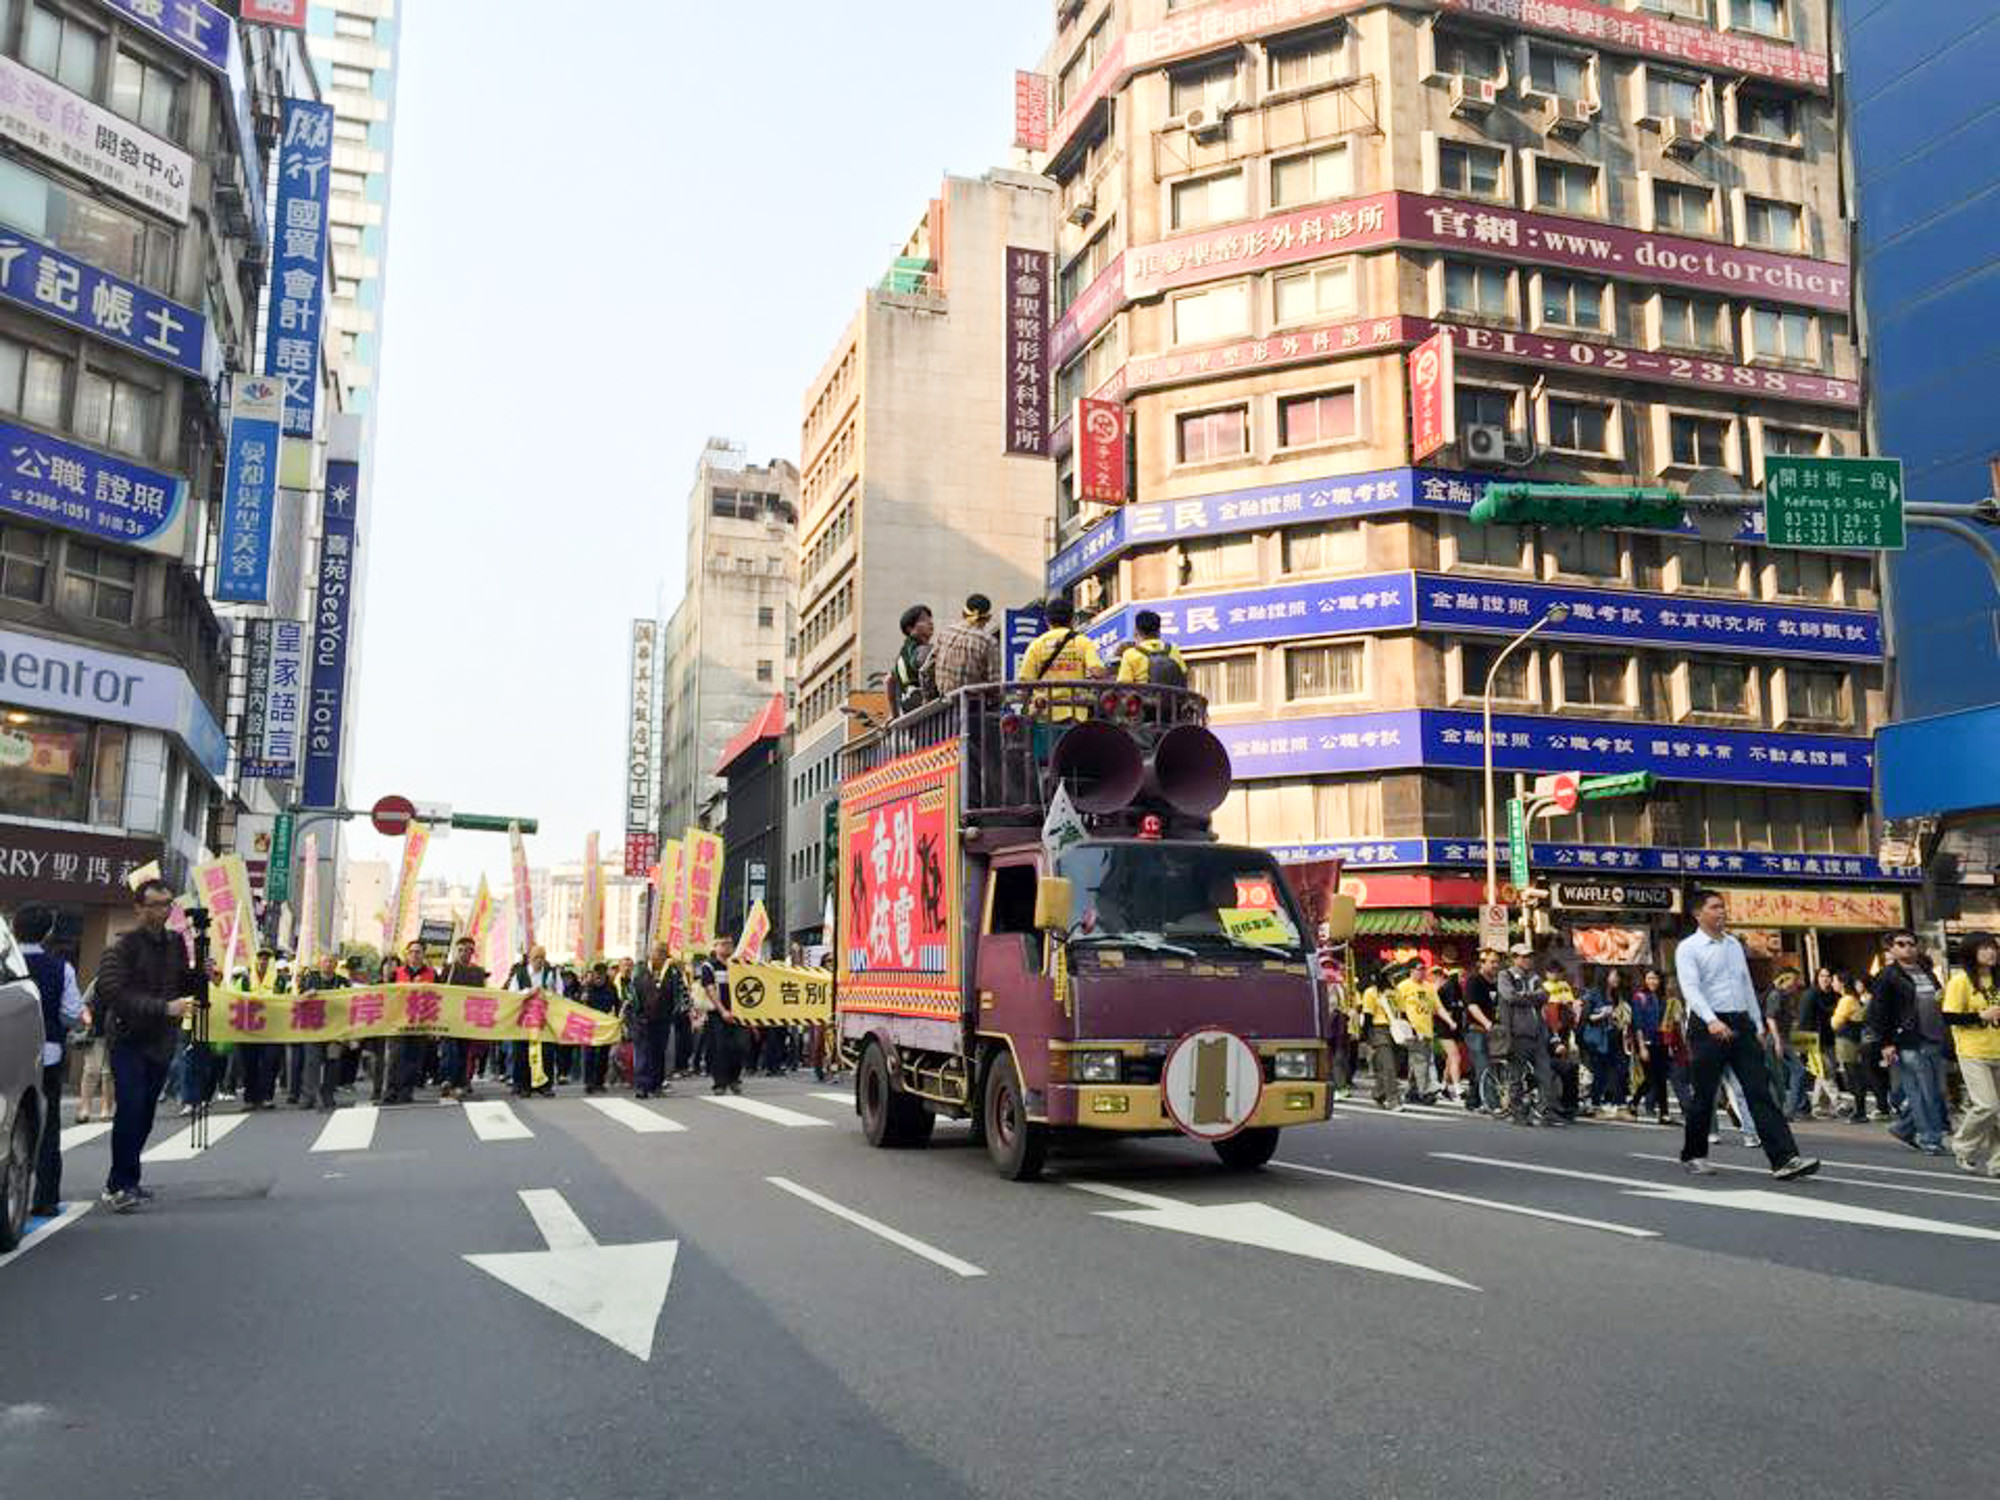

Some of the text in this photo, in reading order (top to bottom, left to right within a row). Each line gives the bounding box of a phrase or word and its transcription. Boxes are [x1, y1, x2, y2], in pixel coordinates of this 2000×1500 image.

[95, 122, 185, 190] 開發中心
[12, 446, 165, 520] 公職 證照
[1421, 477, 1479, 504] 金融
[1778, 468, 1887, 491] 開封街一段
[1132, 481, 1400, 535] 三民 金融證照 公職考試
[1228, 600, 1308, 624] 金融證照
[1317, 590, 1401, 614] 公職考試
[1430, 590, 1531, 617] 金融證照
[1658, 610, 1767, 633] 教育研究所
[1778, 619, 1868, 641] 教師甄試
[0, 652, 143, 707] entor
[268, 624, 301, 757] 皇家語言
[312, 582, 346, 758] SeeYou Hotel
[1319, 729, 1401, 750] 公職考試
[1549, 734, 1635, 754] 公職考試
[1651, 741, 1733, 760] 國營事業
[1749, 746, 1848, 767] 不動產證照
[631, 746, 650, 826] HOTEL
[1555, 848, 1644, 867] 公職考試
[1661, 852, 1744, 871] 國營事業
[1761, 856, 1862, 875] 不動產證照
[1563, 886, 1610, 901] WAFFLE
[780, 982, 826, 1005] 告別
